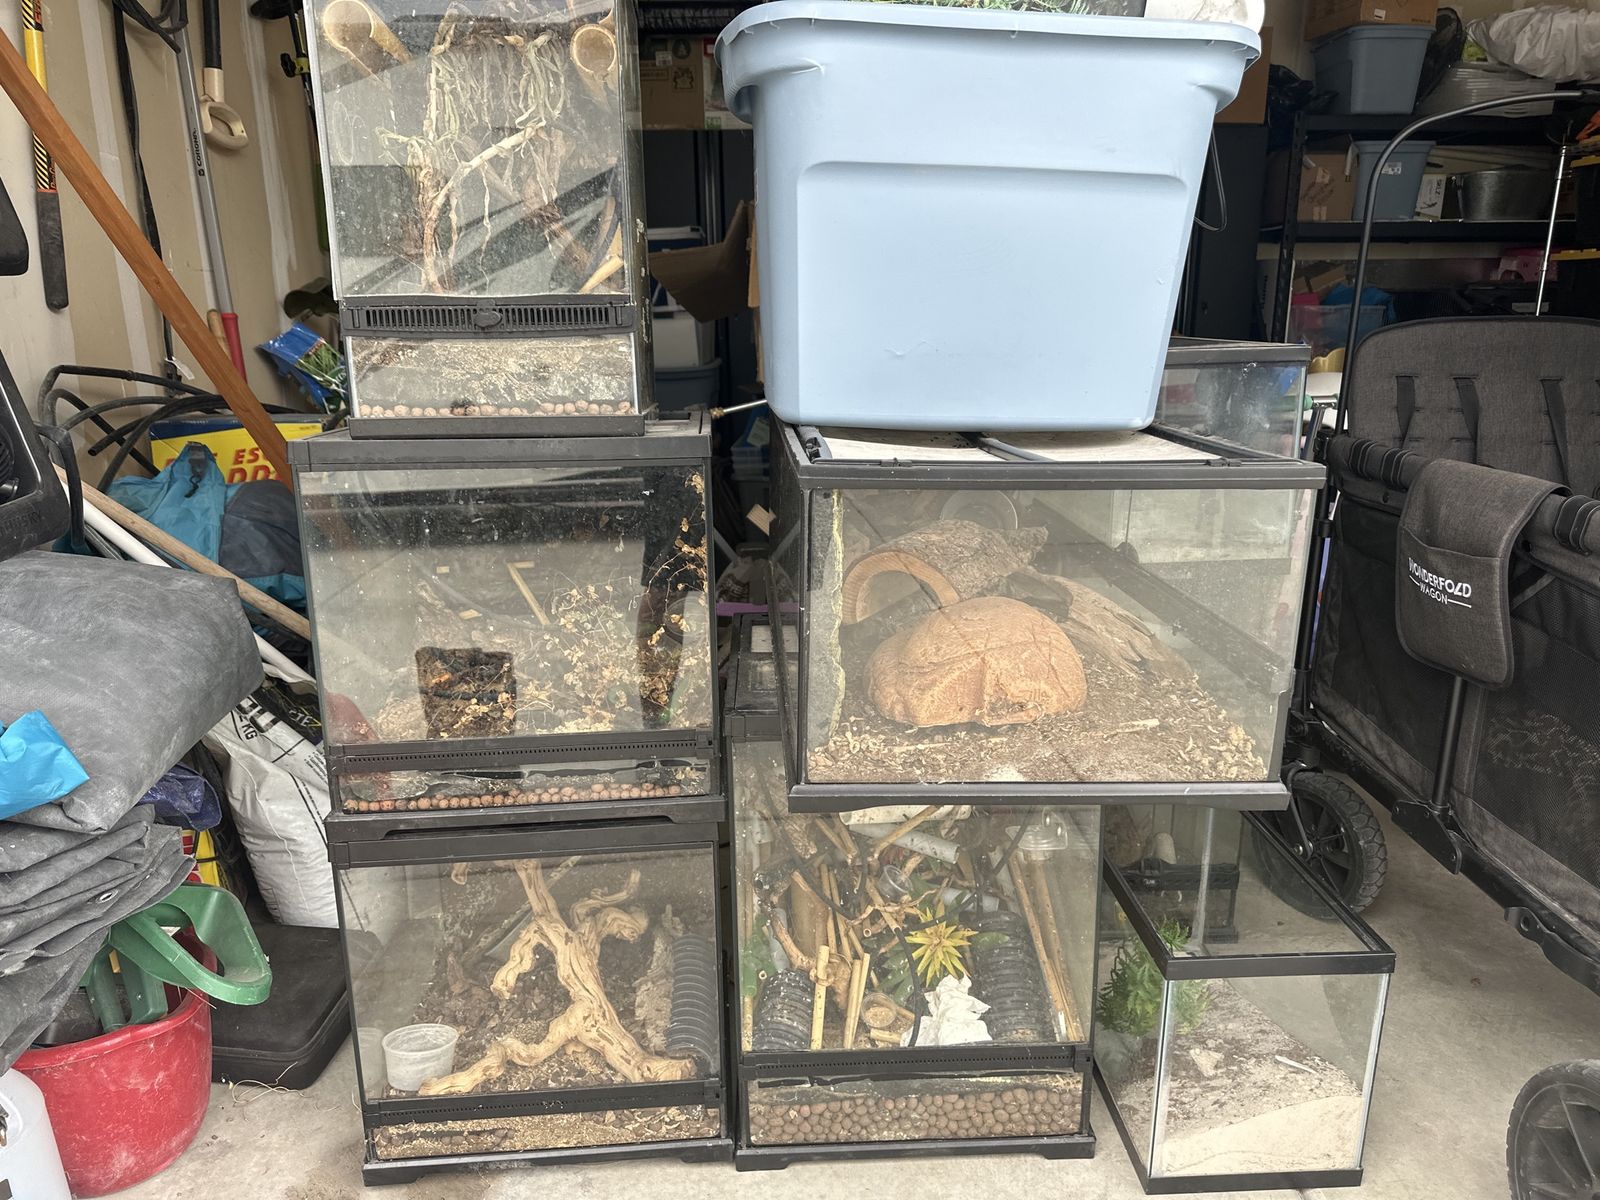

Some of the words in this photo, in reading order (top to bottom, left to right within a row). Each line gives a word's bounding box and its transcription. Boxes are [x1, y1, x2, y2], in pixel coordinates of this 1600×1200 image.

[1408, 556, 1472, 599] WONDERFOLD
[1419, 583, 1448, 605] WAGON
[242, 723, 258, 740] KG
